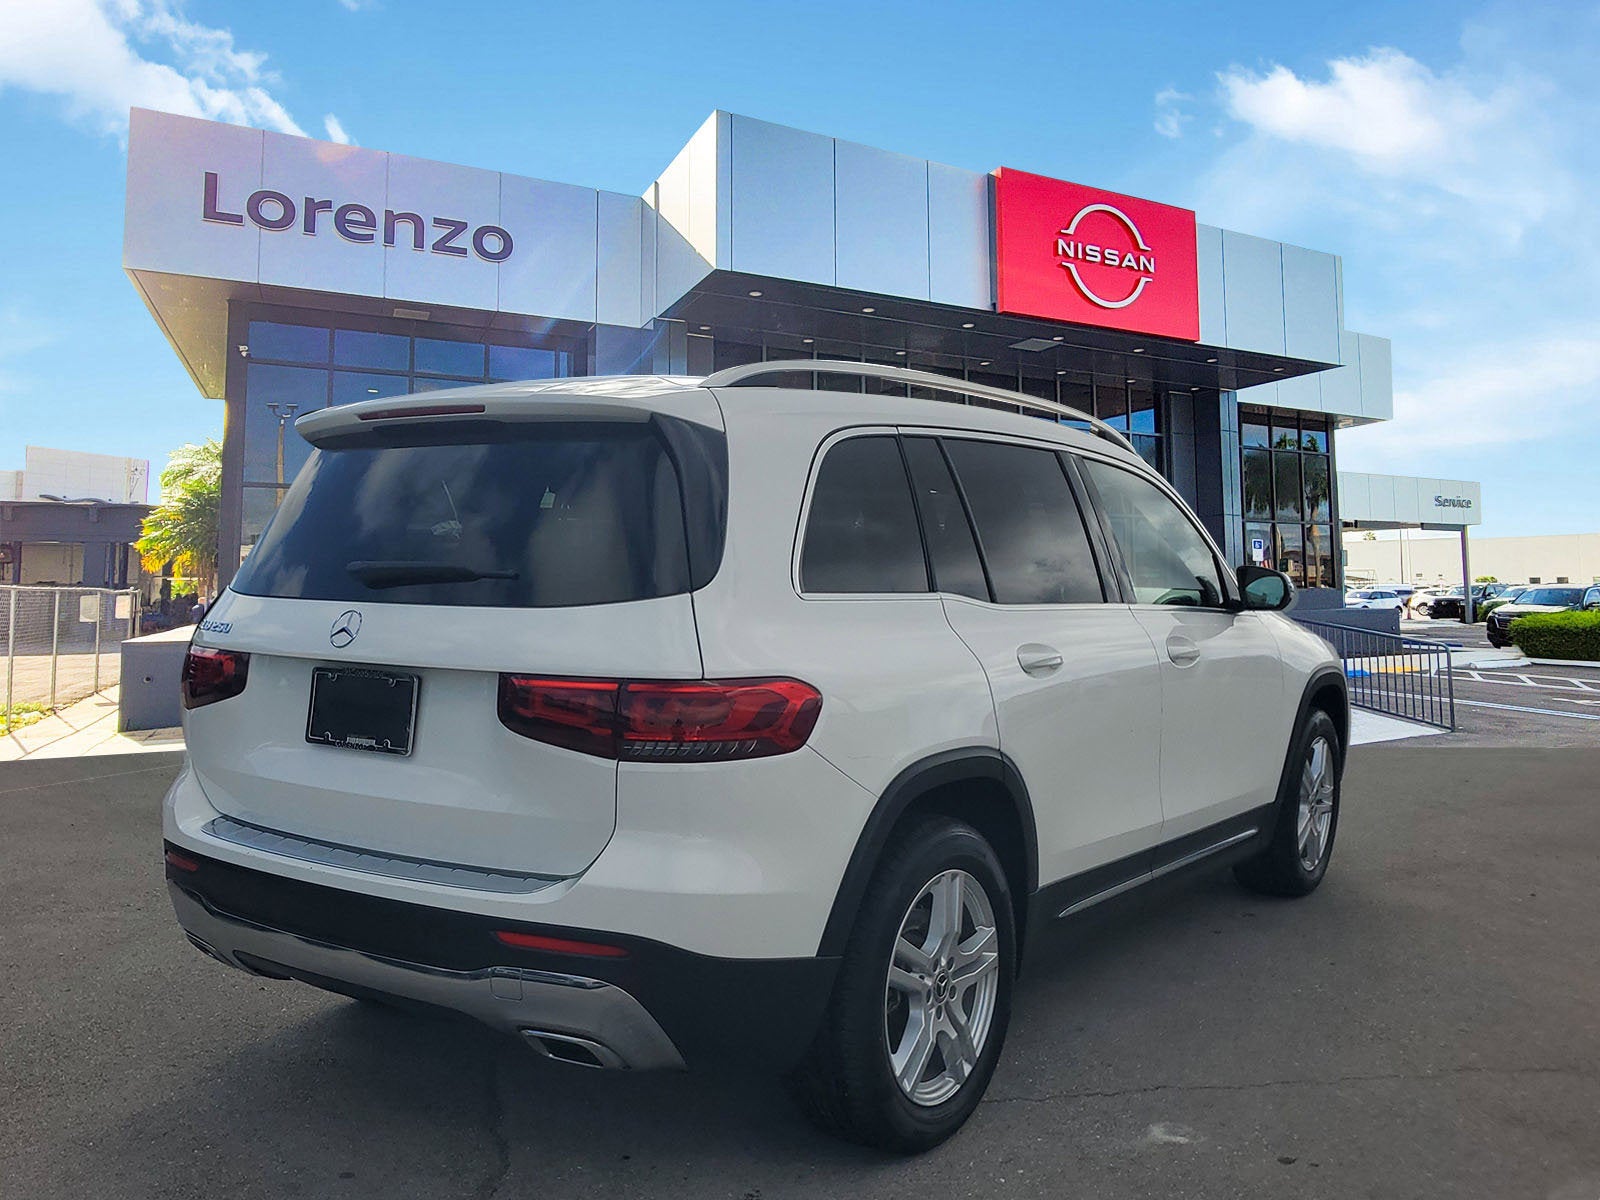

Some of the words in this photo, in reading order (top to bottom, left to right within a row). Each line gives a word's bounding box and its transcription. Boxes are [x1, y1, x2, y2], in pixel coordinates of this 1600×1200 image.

[203, 171, 514, 262] Lorenzo
[1057, 238, 1155, 273] NISSAN
[1434, 495, 1472, 509] Service
